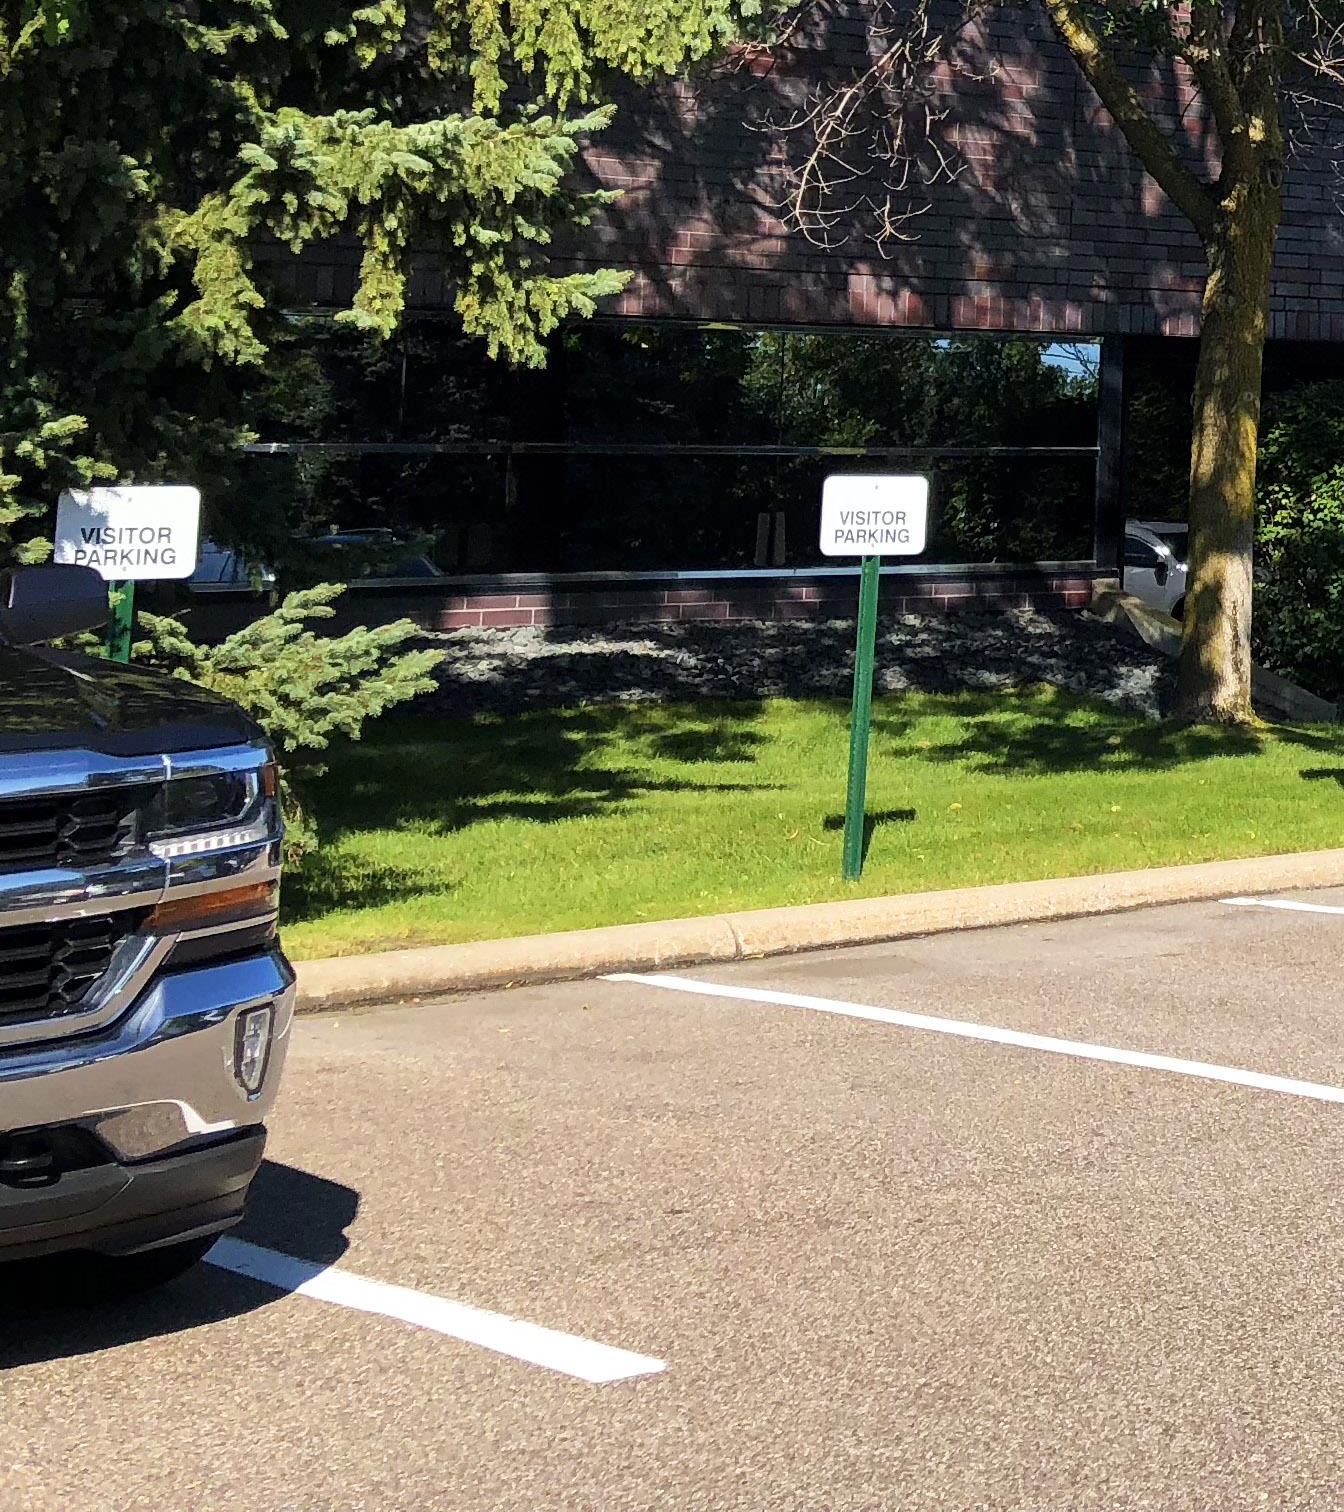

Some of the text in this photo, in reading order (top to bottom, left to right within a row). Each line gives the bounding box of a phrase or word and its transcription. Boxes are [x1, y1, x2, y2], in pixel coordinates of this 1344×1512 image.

[839, 511, 907, 526] VISITOR
[80, 527, 172, 545] VISITOR
[834, 528, 910, 544] PARKING
[74, 548, 177, 566] PARKING
